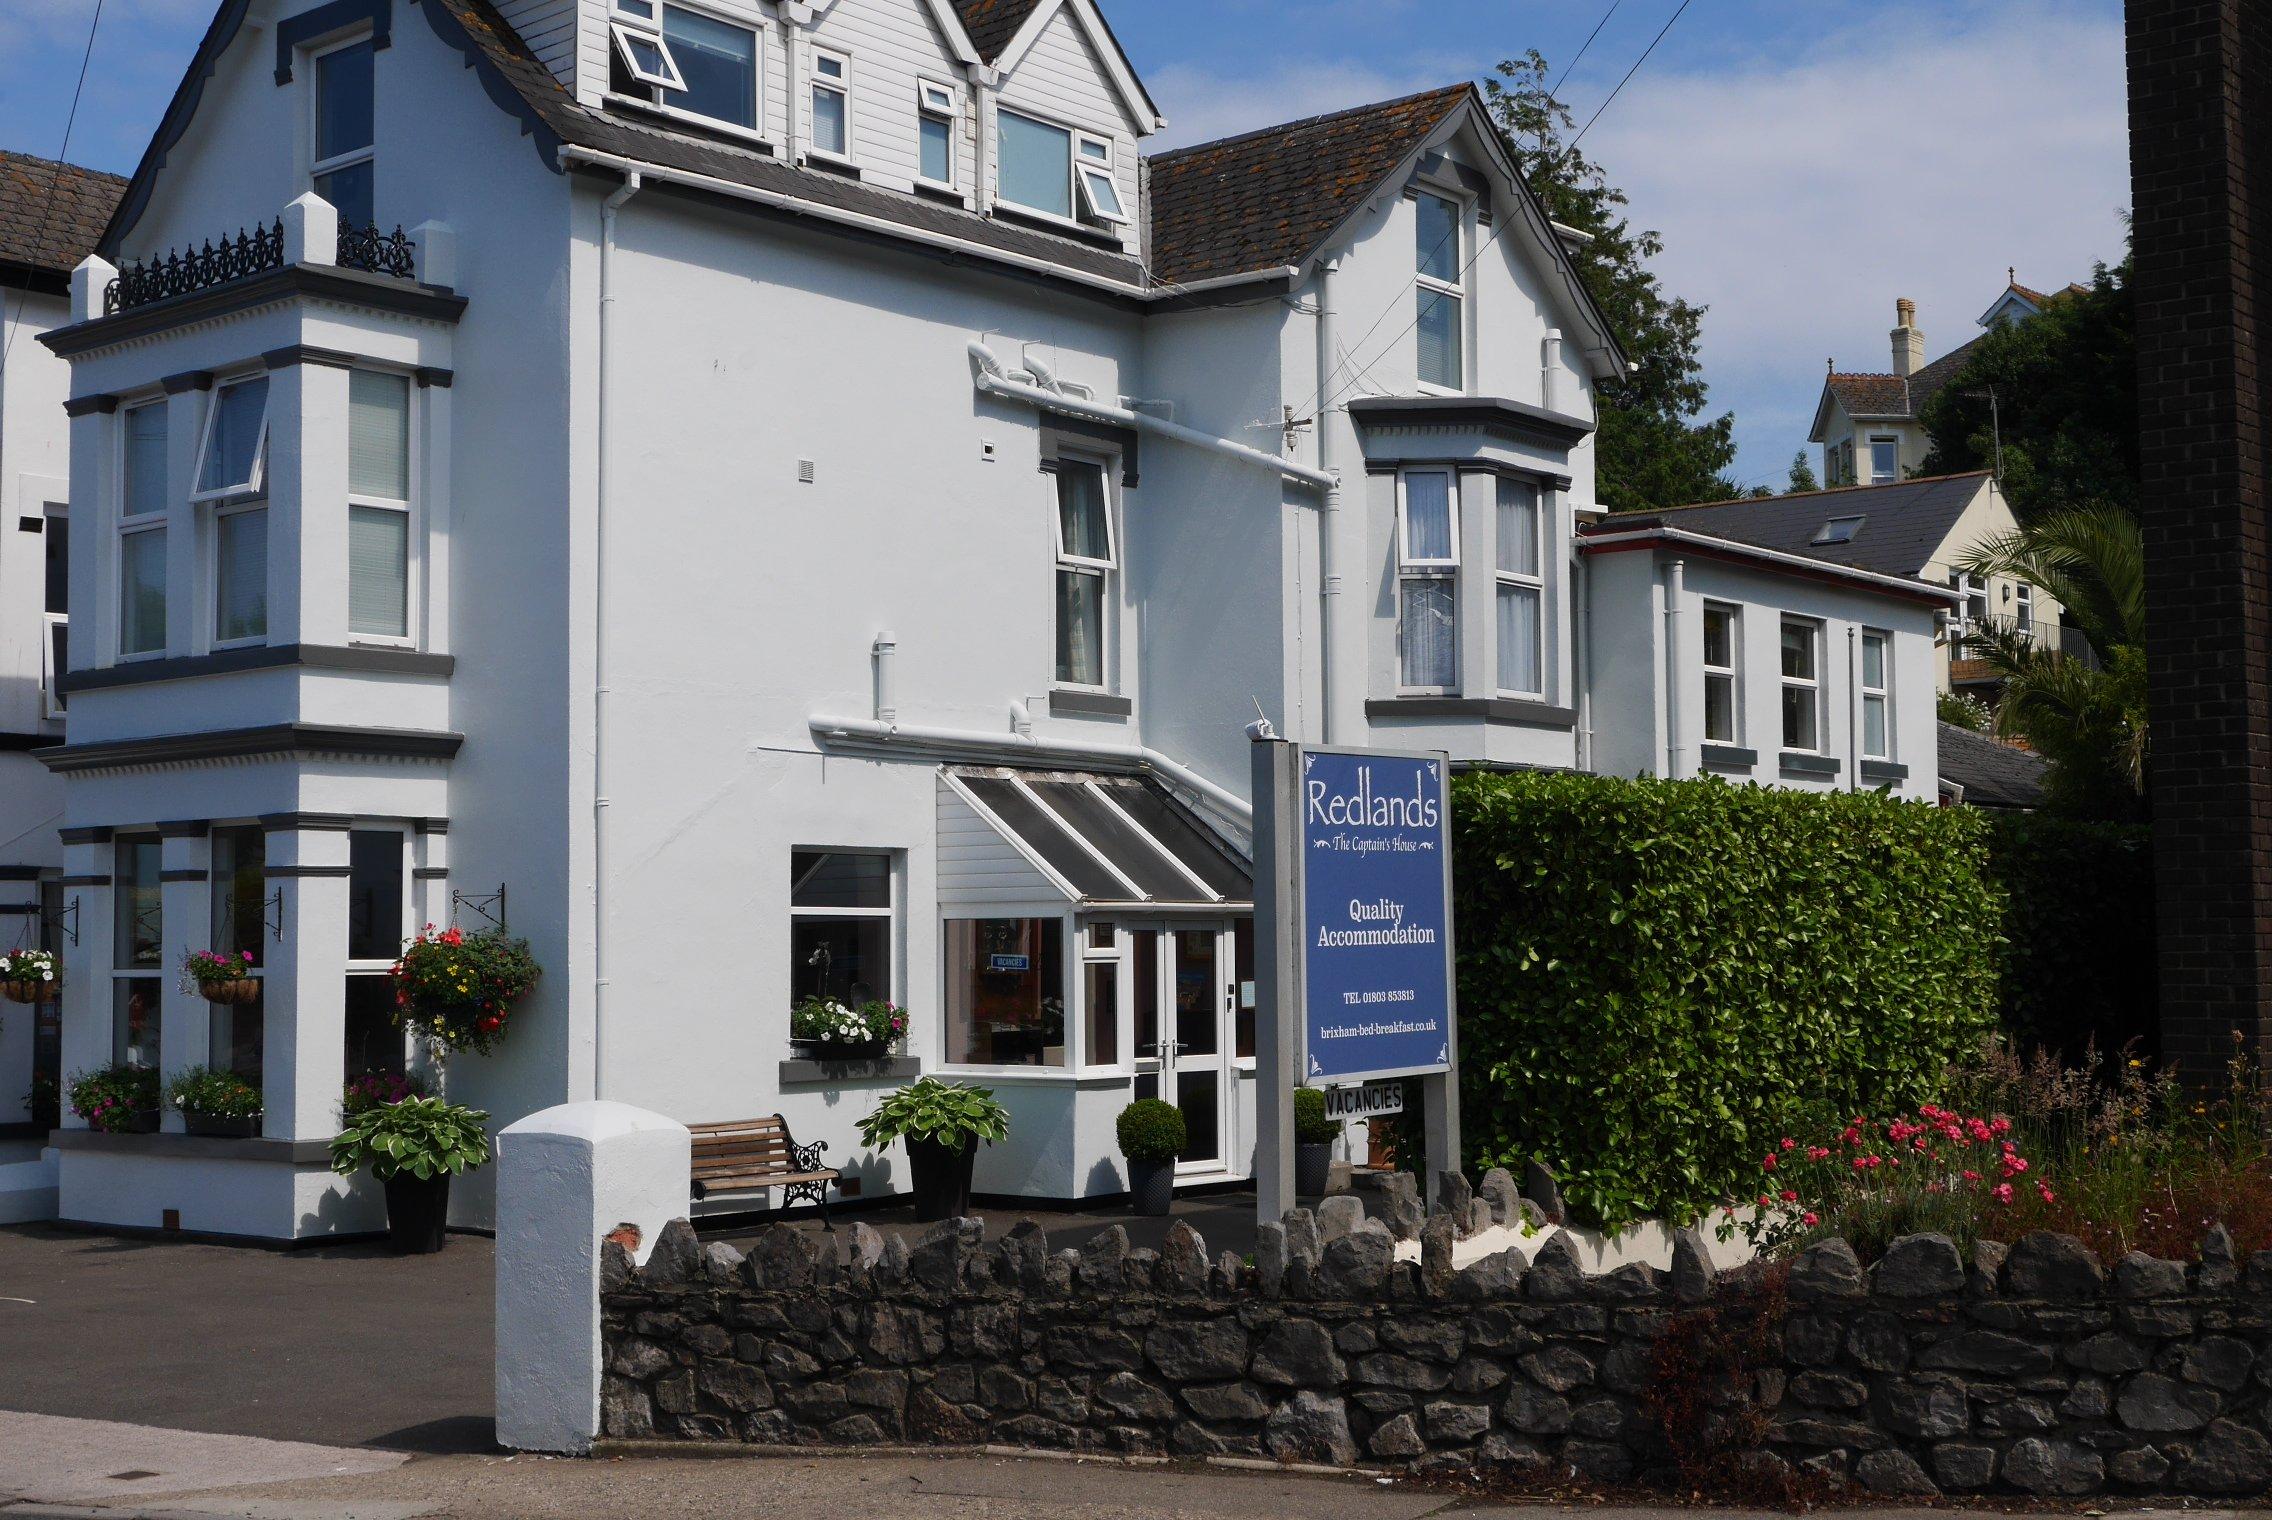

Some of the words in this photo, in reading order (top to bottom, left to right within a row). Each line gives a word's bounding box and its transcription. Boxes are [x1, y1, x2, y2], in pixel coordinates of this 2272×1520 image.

[1308, 766, 1438, 828] Redlands
[1332, 833, 1350, 851] The
[1352, 837, 1391, 859] Captain's
[1392, 834, 1417, 852] House
[1350, 898, 1405, 925] Quality
[1317, 923, 1436, 947] Accommodation
[996, 957, 1023, 967] VACANCIES
[1343, 992, 1361, 1005] TEL
[1363, 991, 1386, 1003] 01803
[1320, 1018, 1437, 1039] brixham-bed-breakfast.co.uk
[1326, 1086, 1402, 1117] VACANCIES
